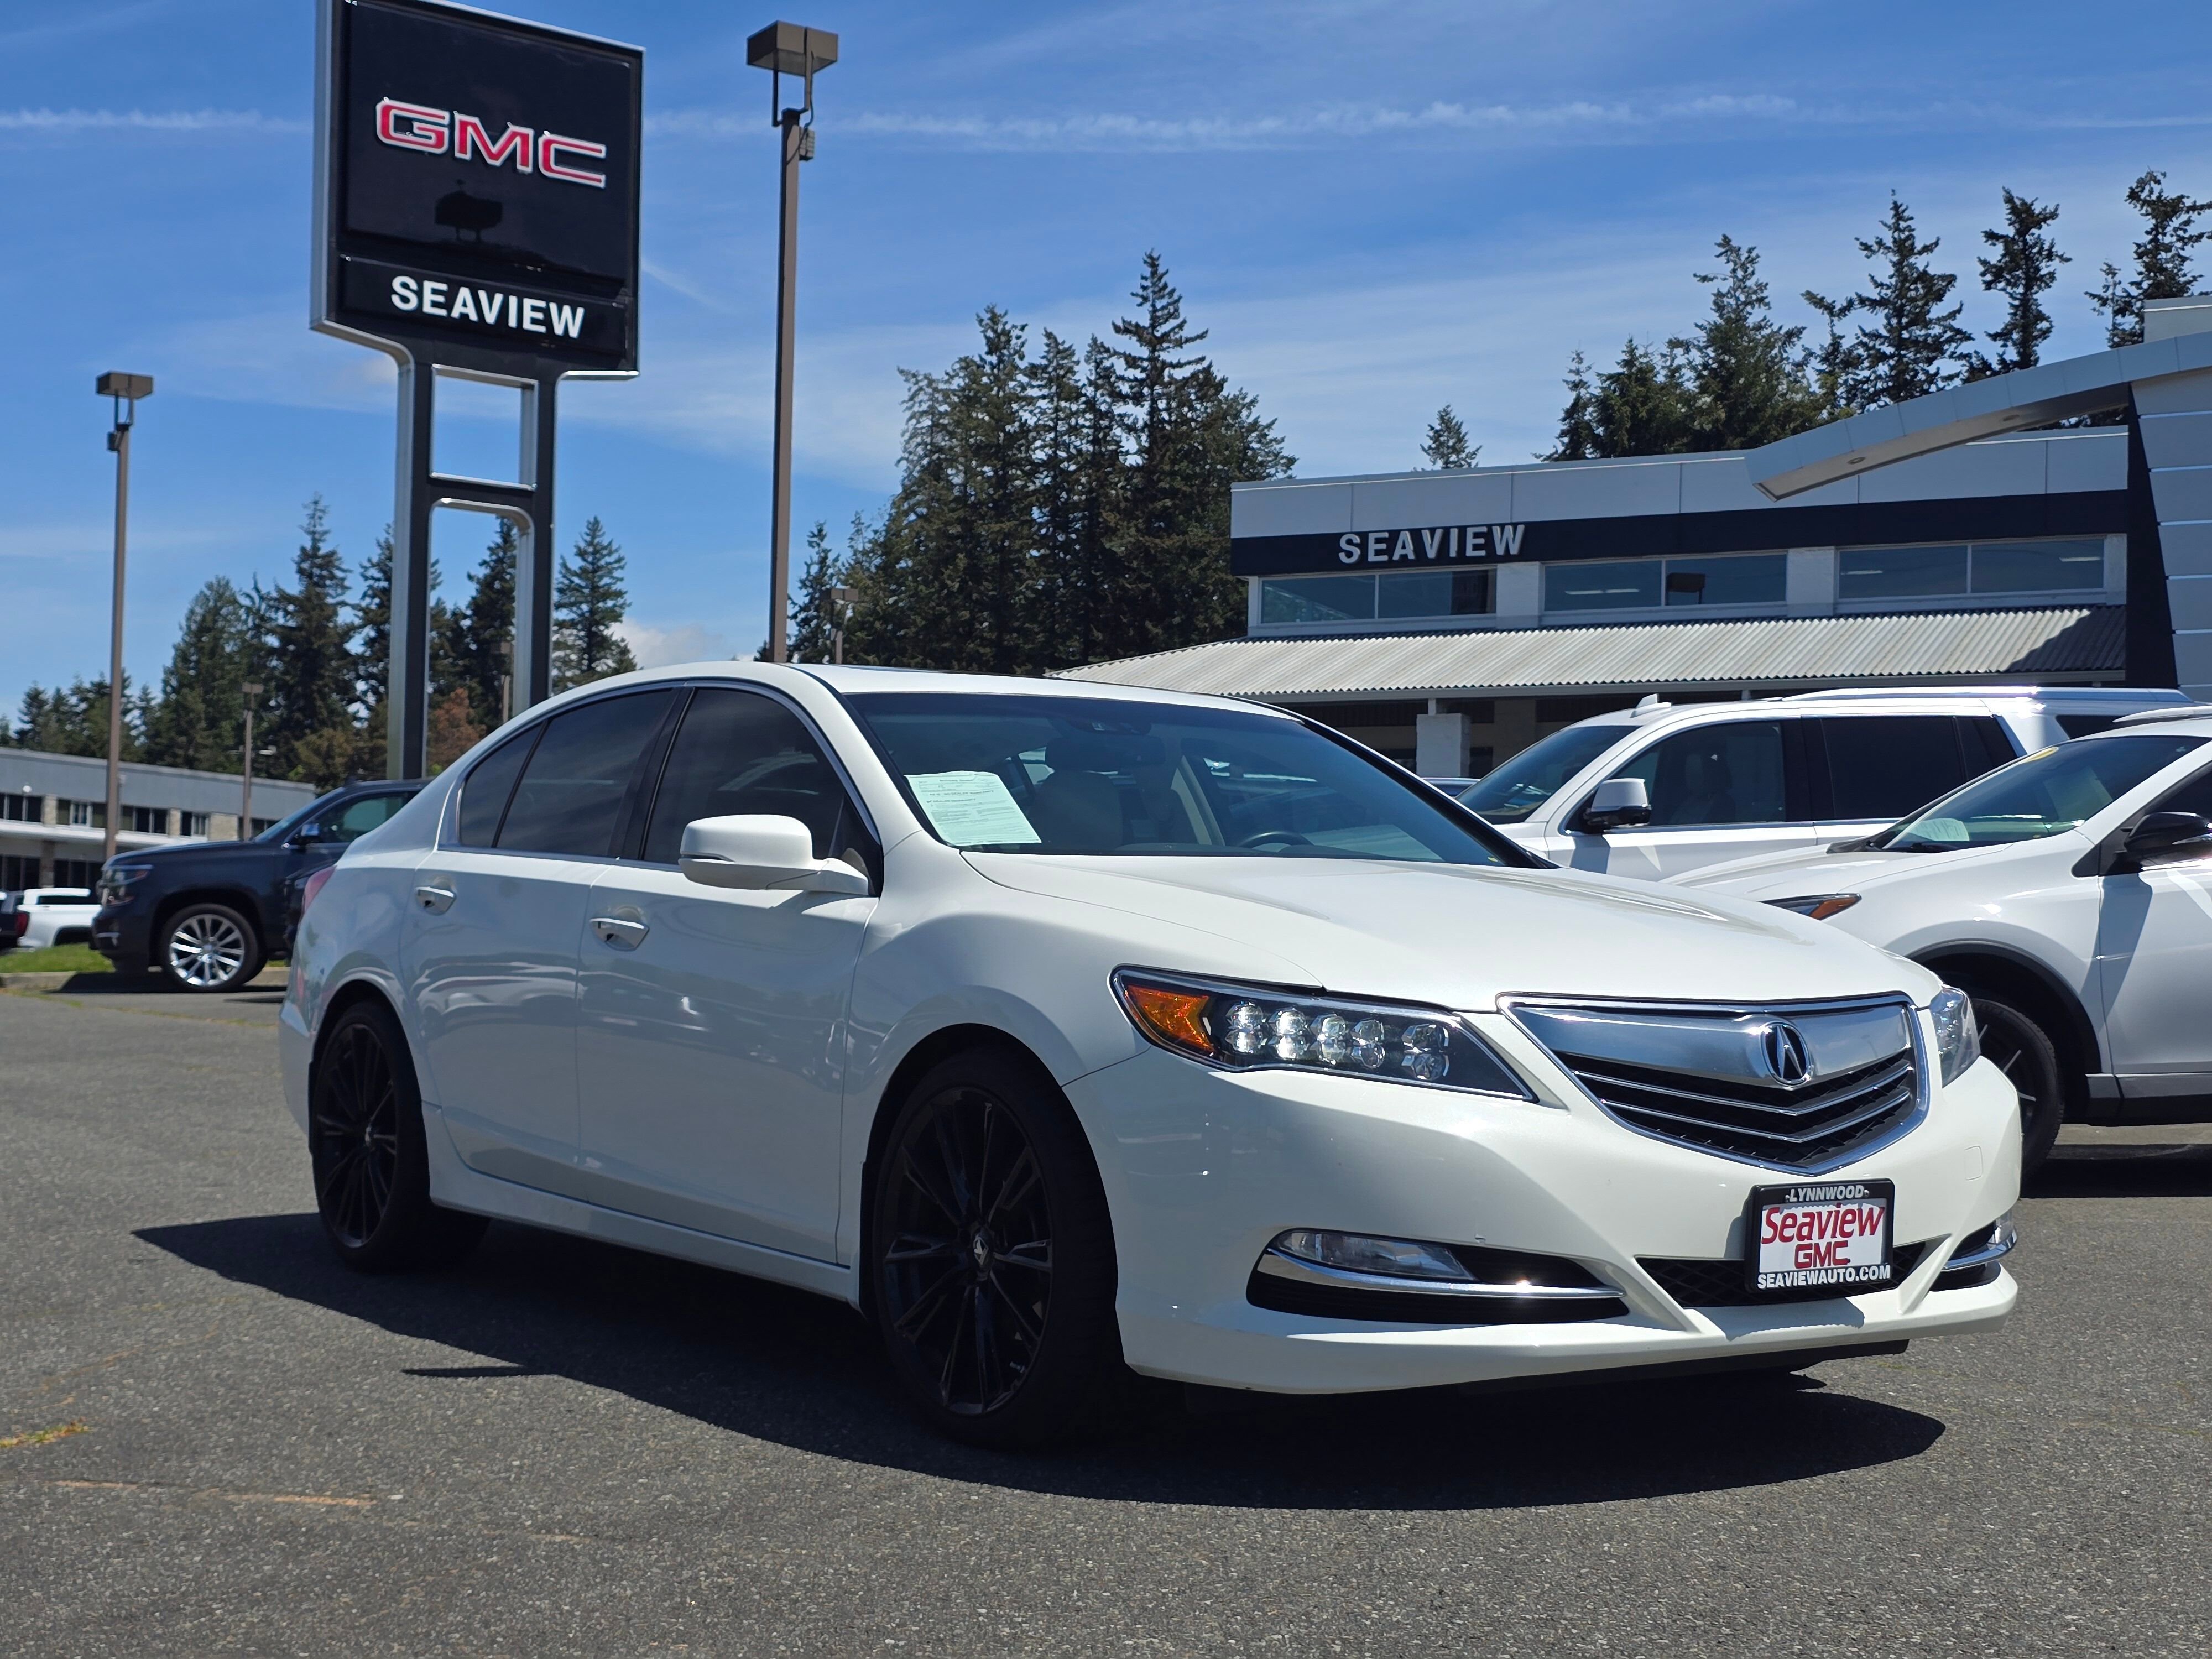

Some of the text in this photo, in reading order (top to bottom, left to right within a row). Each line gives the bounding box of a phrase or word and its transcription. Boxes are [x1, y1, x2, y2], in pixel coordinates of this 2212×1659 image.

[376, 98, 607, 189] GMC
[391, 275, 585, 338] SEAVIEW
[1339, 524, 1525, 564] SEAVIEW
[1789, 1185, 1864, 1202] LYNNWOOD
[1761, 1202, 1885, 1244] Seaview
[1794, 1240, 1851, 1269] GMC
[1757, 1265, 1890, 1290] SEAVIEWAUTO.COM
